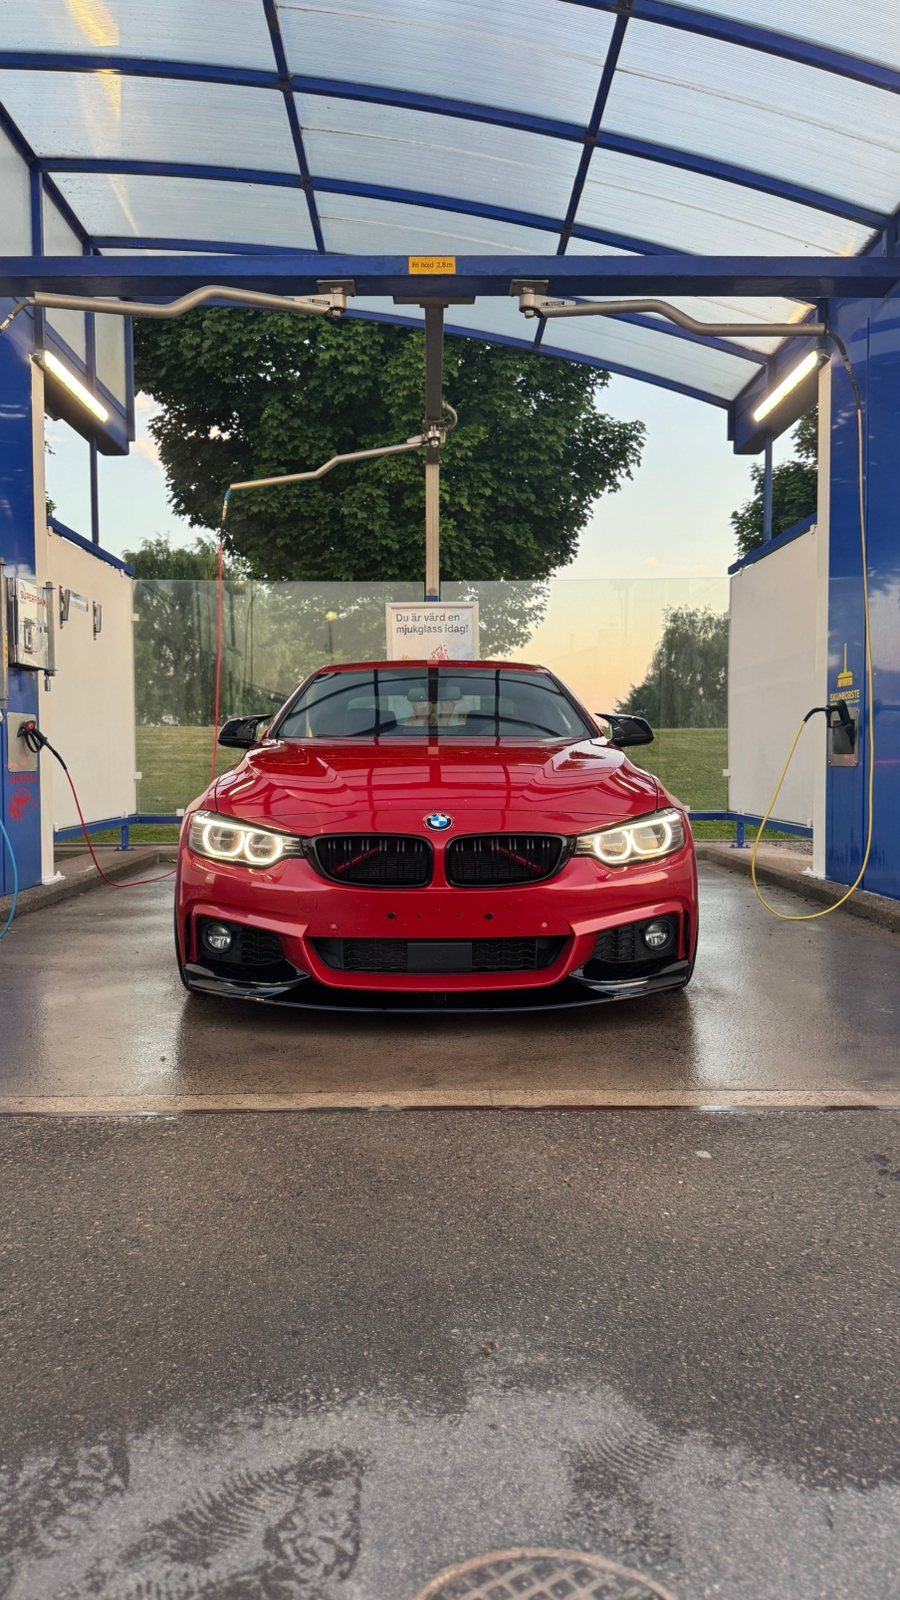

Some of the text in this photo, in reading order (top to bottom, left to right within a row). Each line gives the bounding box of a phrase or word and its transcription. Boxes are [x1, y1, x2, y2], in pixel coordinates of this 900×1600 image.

[420, 261, 434, 269] höjd
[396, 612, 460, 622] Du är värd en
[396, 624, 469, 635] mjukglass idag!
